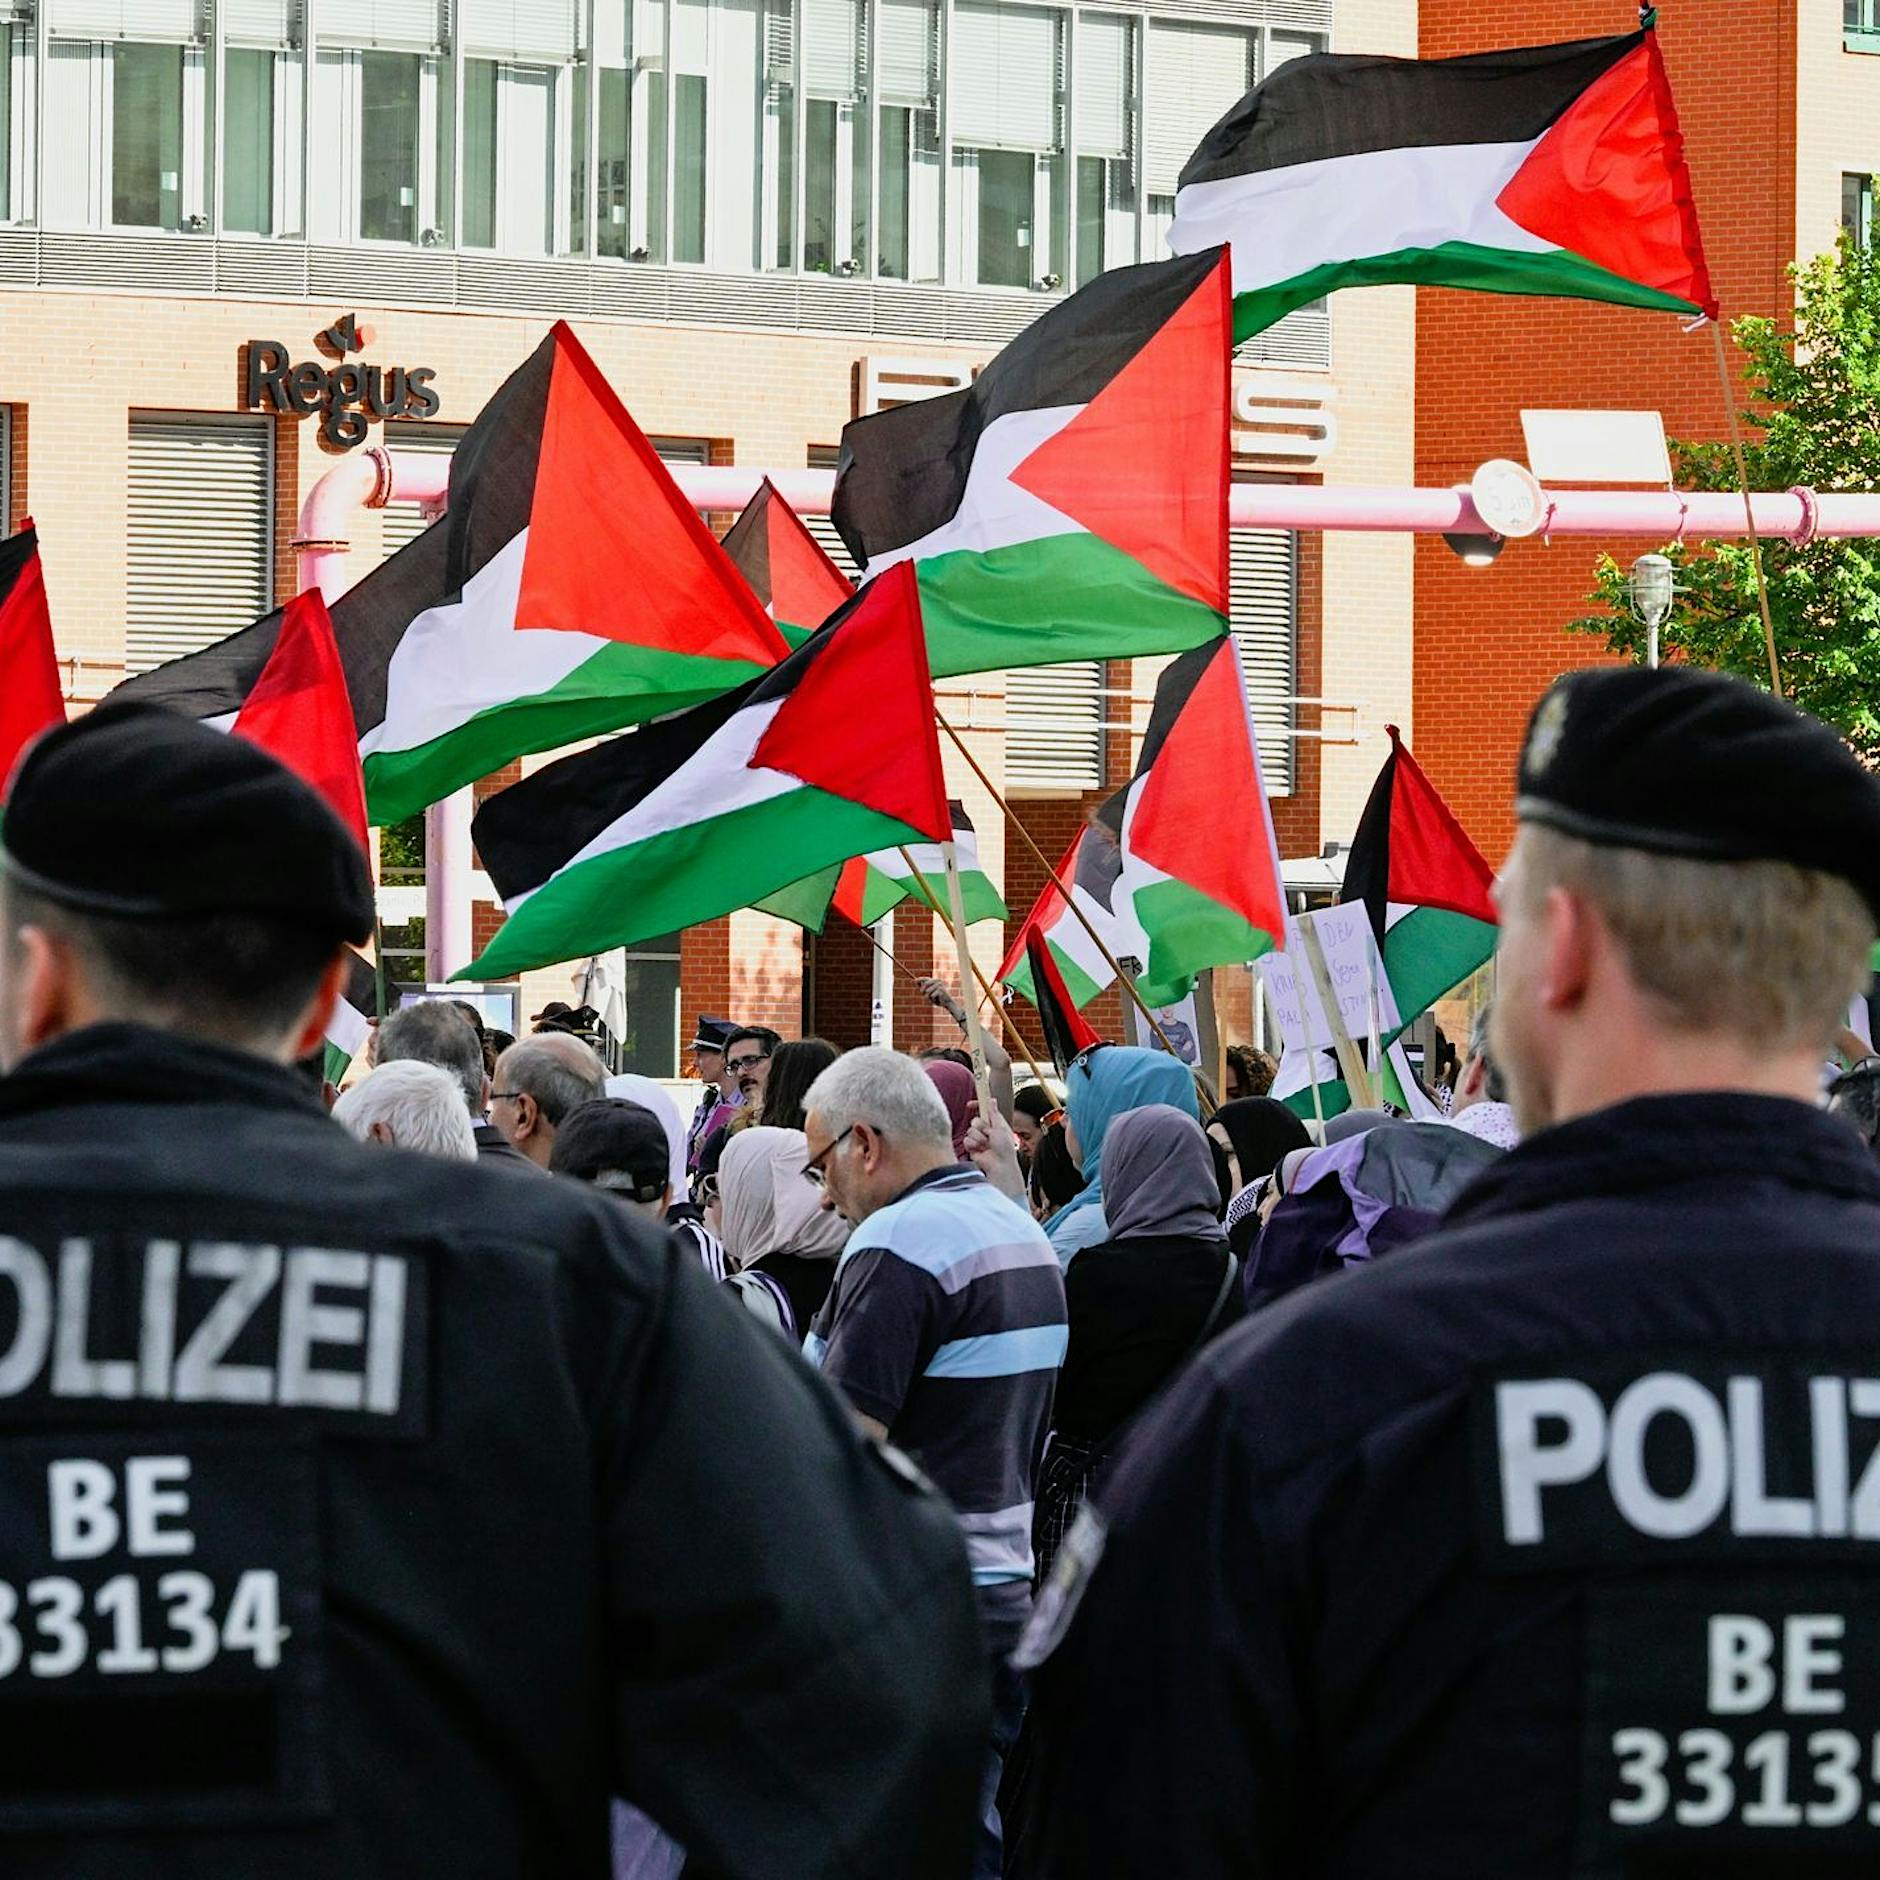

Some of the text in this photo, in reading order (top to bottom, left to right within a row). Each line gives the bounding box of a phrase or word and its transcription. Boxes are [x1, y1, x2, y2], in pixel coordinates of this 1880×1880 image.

[247, 340, 440, 447] Regus
[47, 1456, 195, 1560] BE
[1707, 1614, 1846, 1715] BE
[1609, 1727, 1880, 1827] 3313
